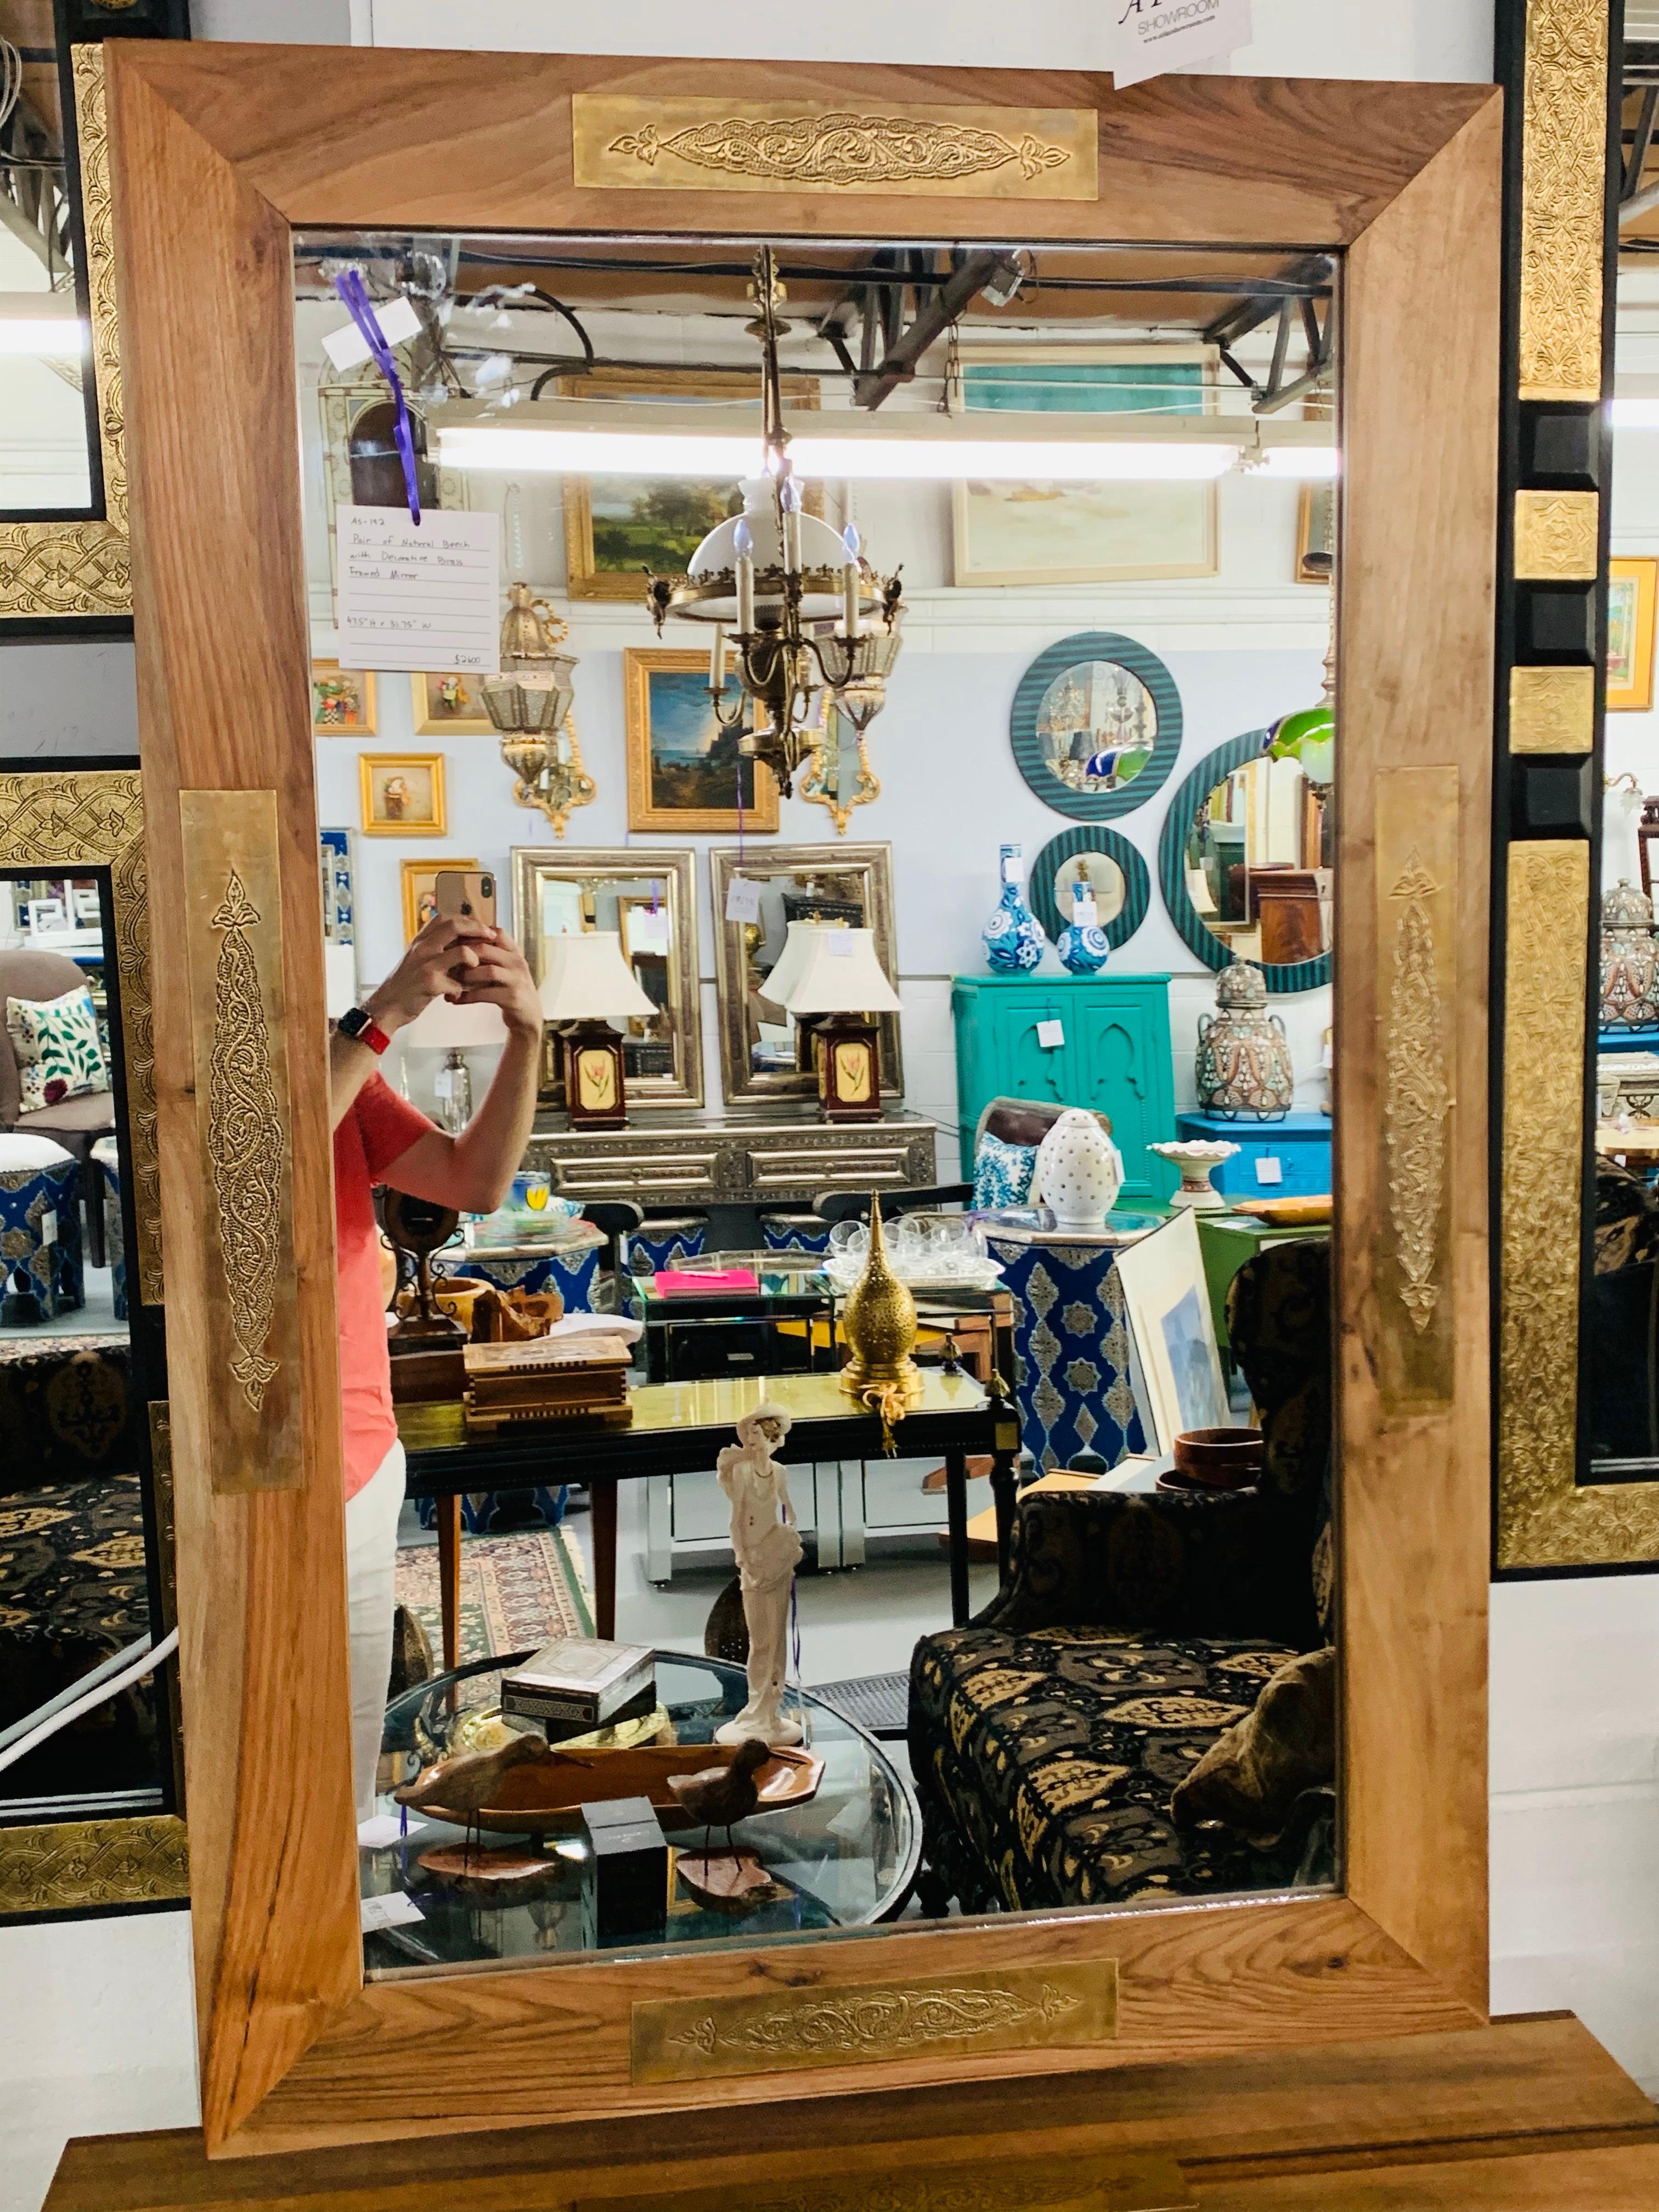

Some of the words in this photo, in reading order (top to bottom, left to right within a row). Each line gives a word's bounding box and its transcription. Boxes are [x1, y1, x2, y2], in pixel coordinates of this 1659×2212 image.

[1138, 0, 1219, 35] SHOWROOM
[353, 533, 371, 544] Pair
[383, 535, 394, 544] of
[402, 538, 434, 548] Natural
[443, 540, 470, 549] Beech
[381, 551, 428, 562] Decorative
[437, 556, 463, 566] Brass
[349, 566, 380, 577] Framed
[390, 570, 419, 579] Mirror
